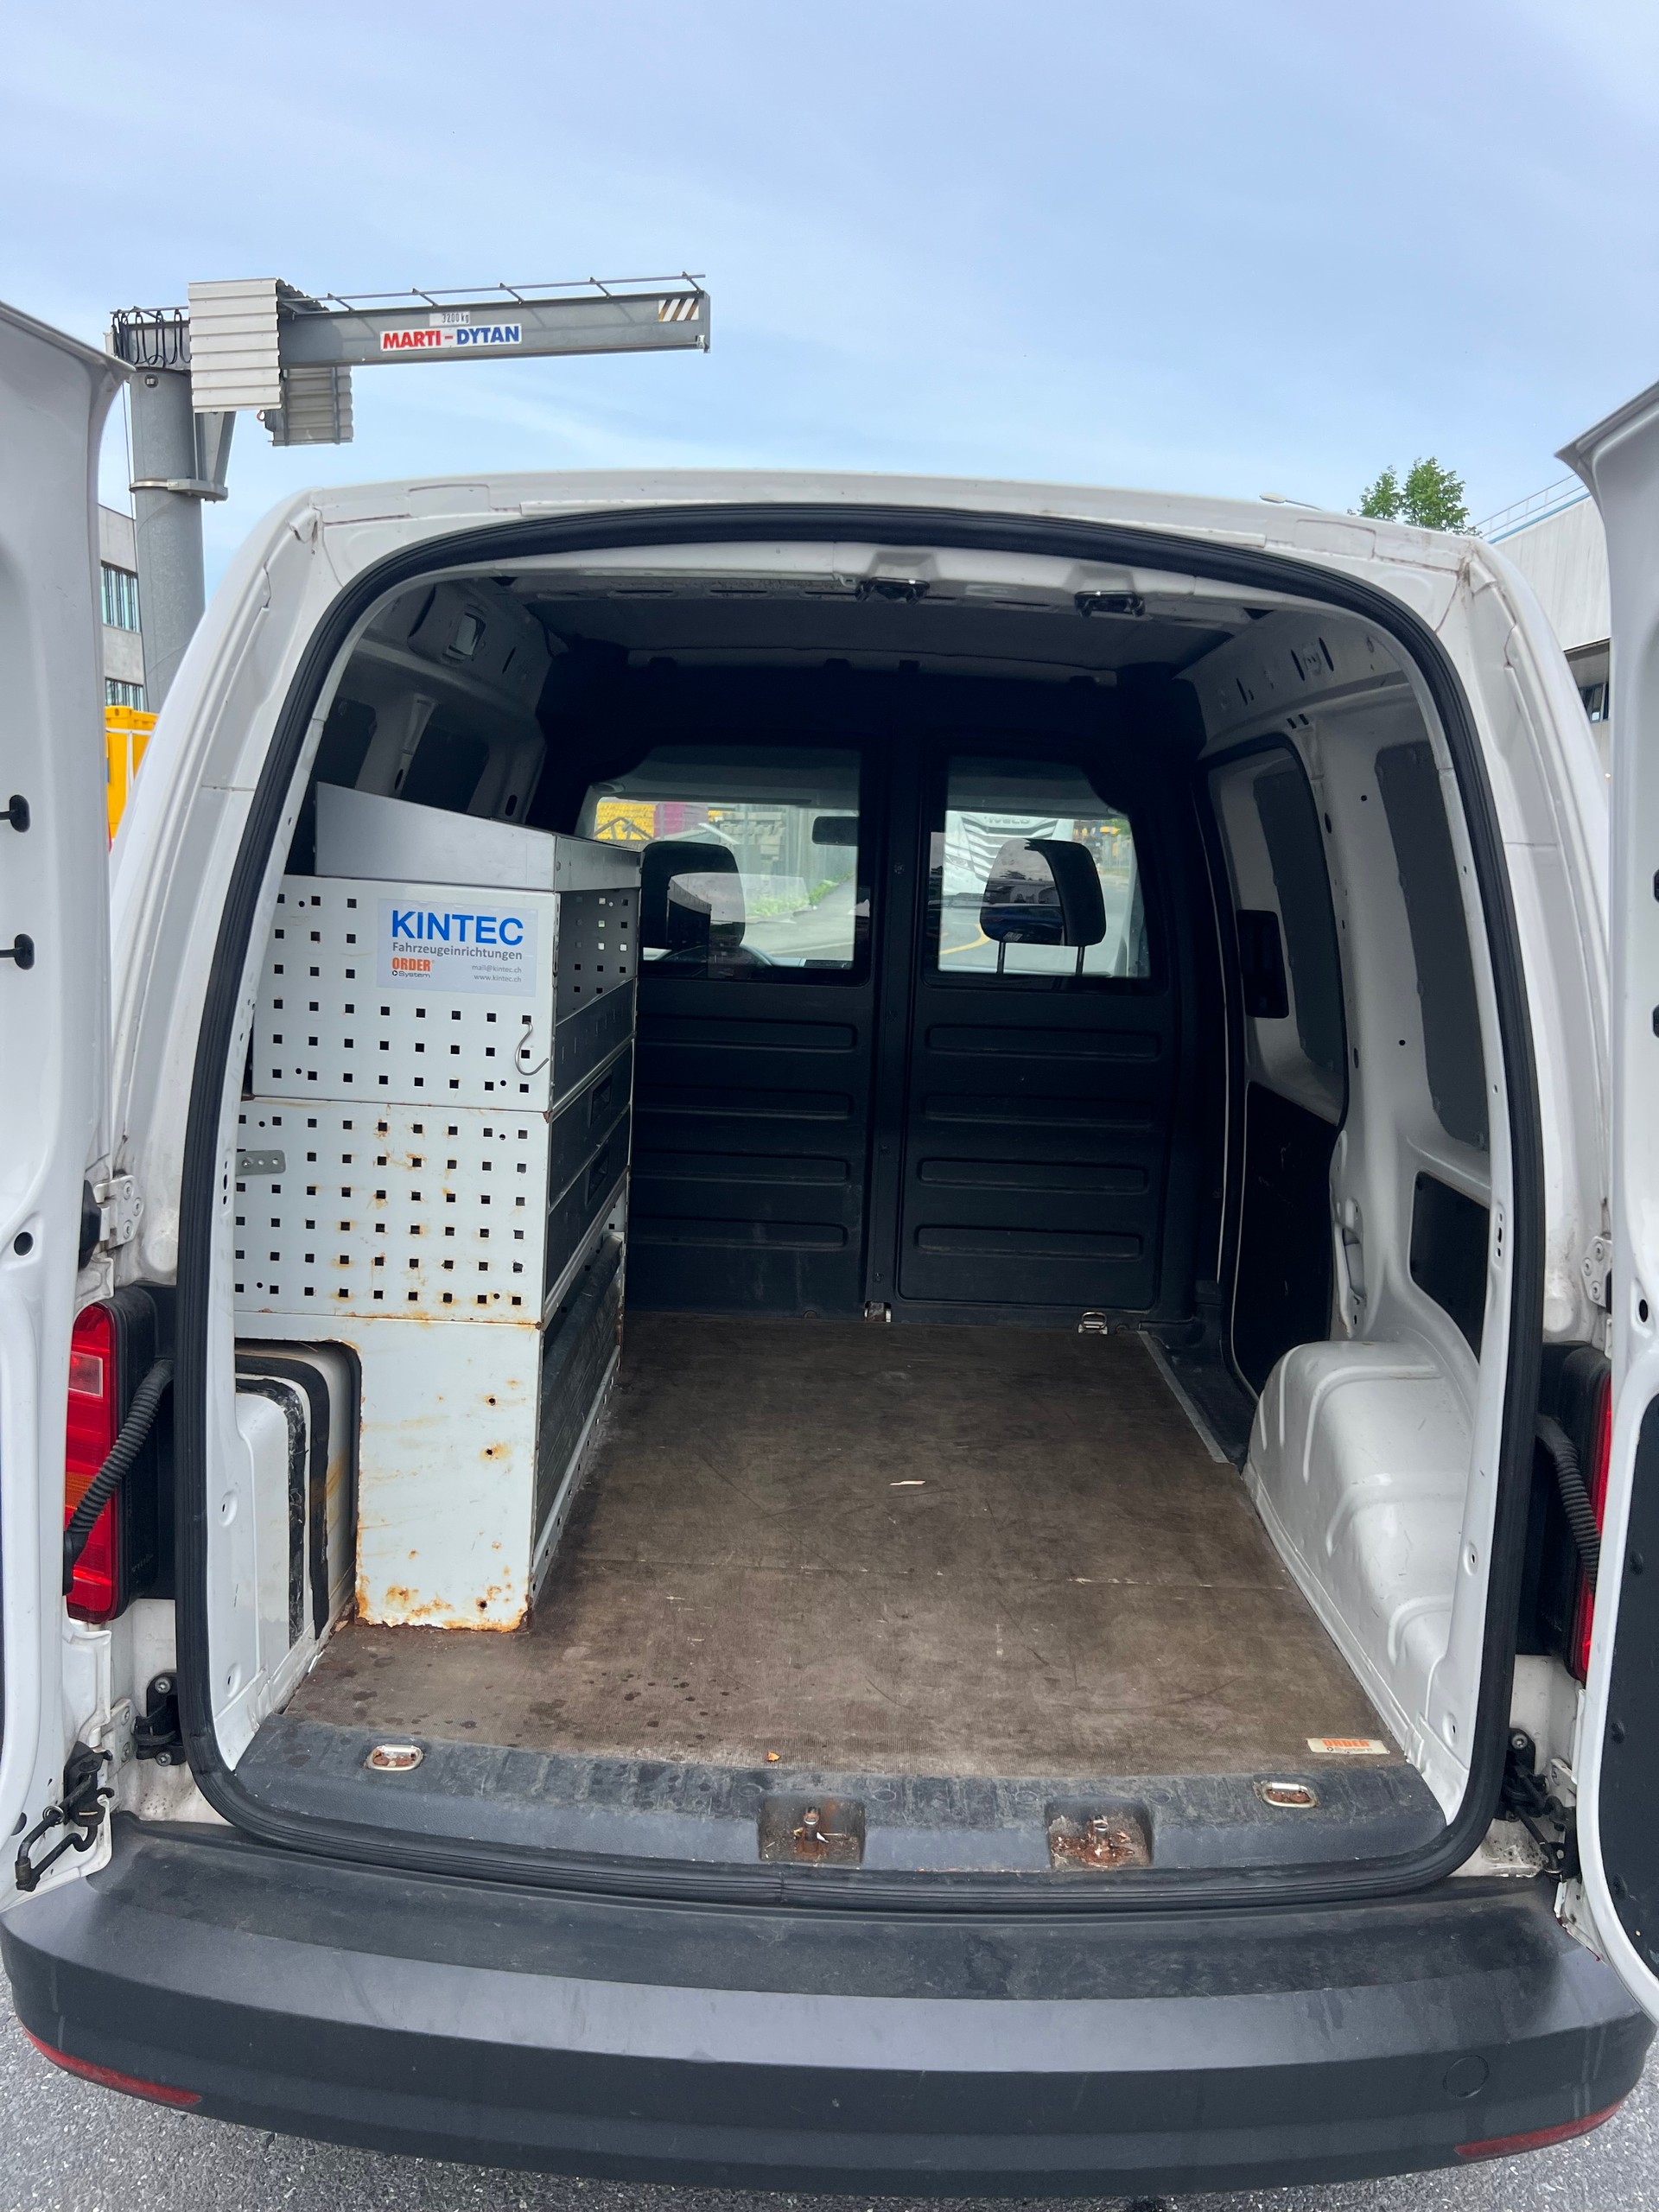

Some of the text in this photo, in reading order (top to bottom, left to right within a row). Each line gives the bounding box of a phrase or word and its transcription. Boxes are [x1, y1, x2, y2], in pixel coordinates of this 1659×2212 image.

[383, 330, 442, 349] MARTI
[456, 326, 519, 345] DYTAN
[391, 910, 524, 946] KINTEC
[392, 942, 523, 961] Fahrzeugeinrichtungen
[392, 957, 431, 971] ORDER
